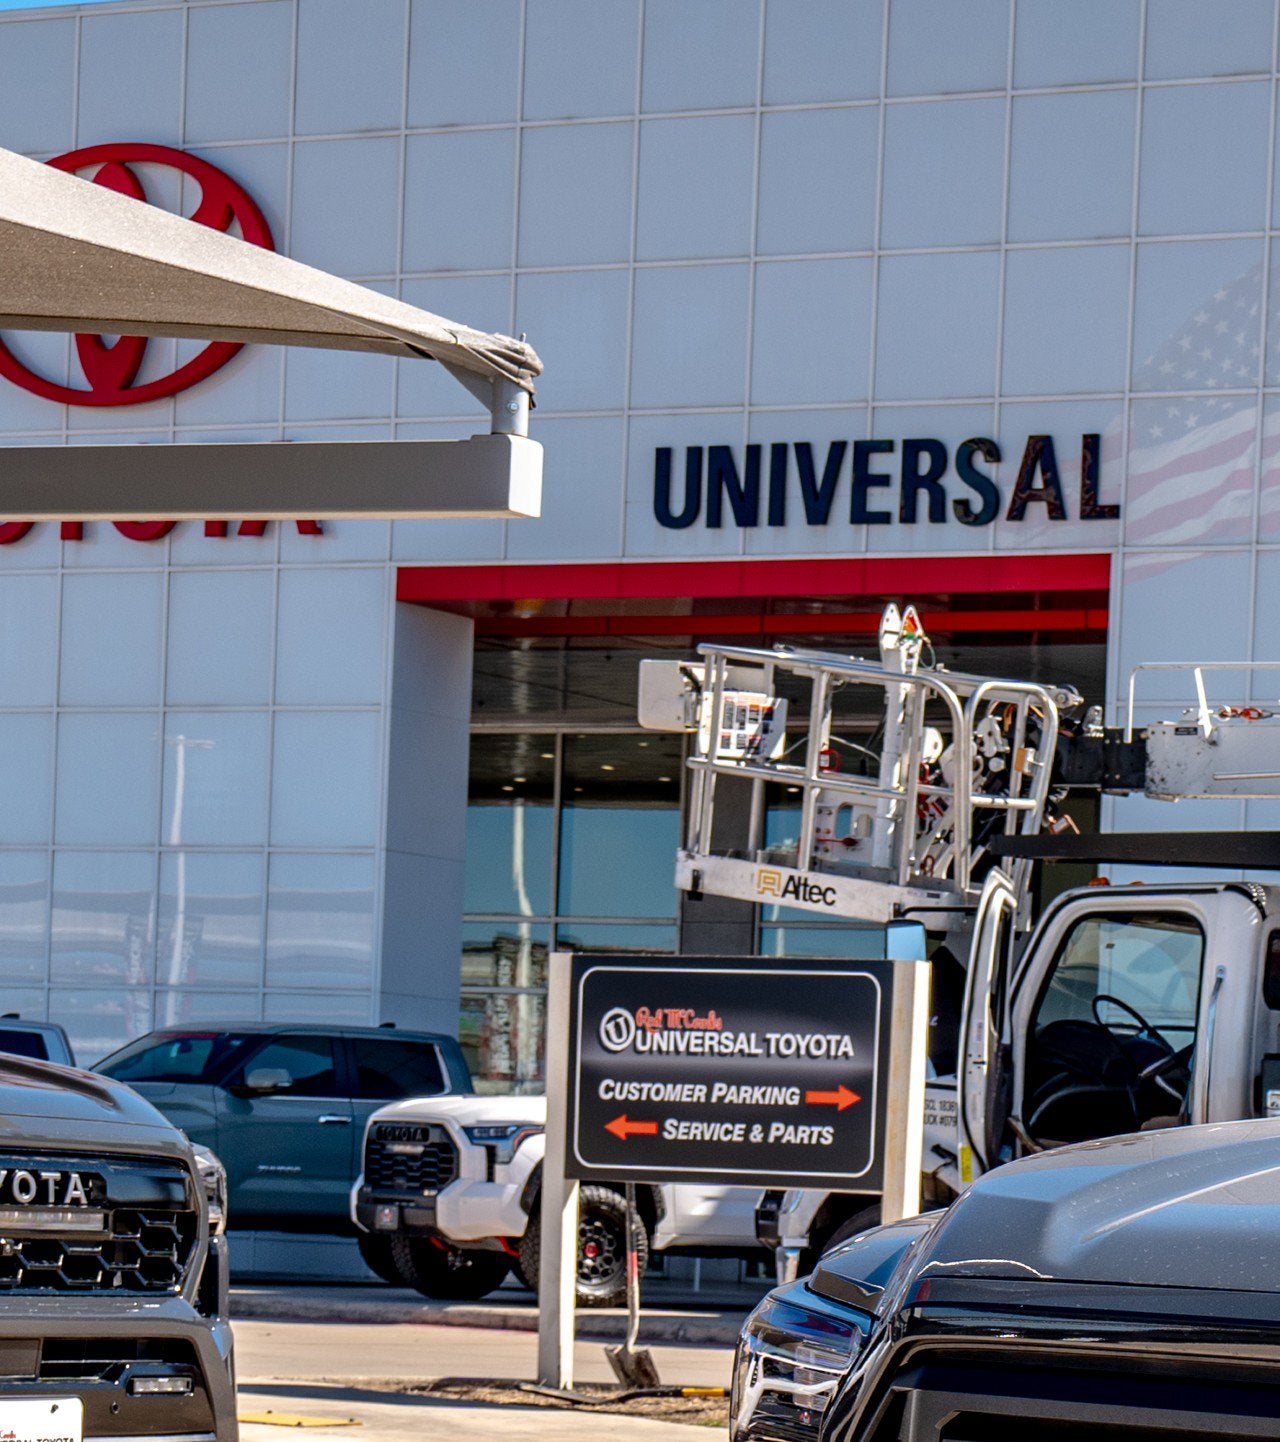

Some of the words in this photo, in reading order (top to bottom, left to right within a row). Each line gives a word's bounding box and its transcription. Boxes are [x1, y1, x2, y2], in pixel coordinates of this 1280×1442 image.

[652, 433, 1121, 529] UNIVERSAL
[781, 874, 837, 907] Altec
[635, 1030, 763, 1056] UNIVERSAL
[766, 1033, 855, 1058] TOYOTA
[599, 1079, 708, 1103] CUSTOMER
[711, 1082, 801, 1106] PARKING
[662, 1118, 745, 1142] SERVICE
[749, 1123, 765, 1142] &
[767, 1121, 835, 1146] PARTS
